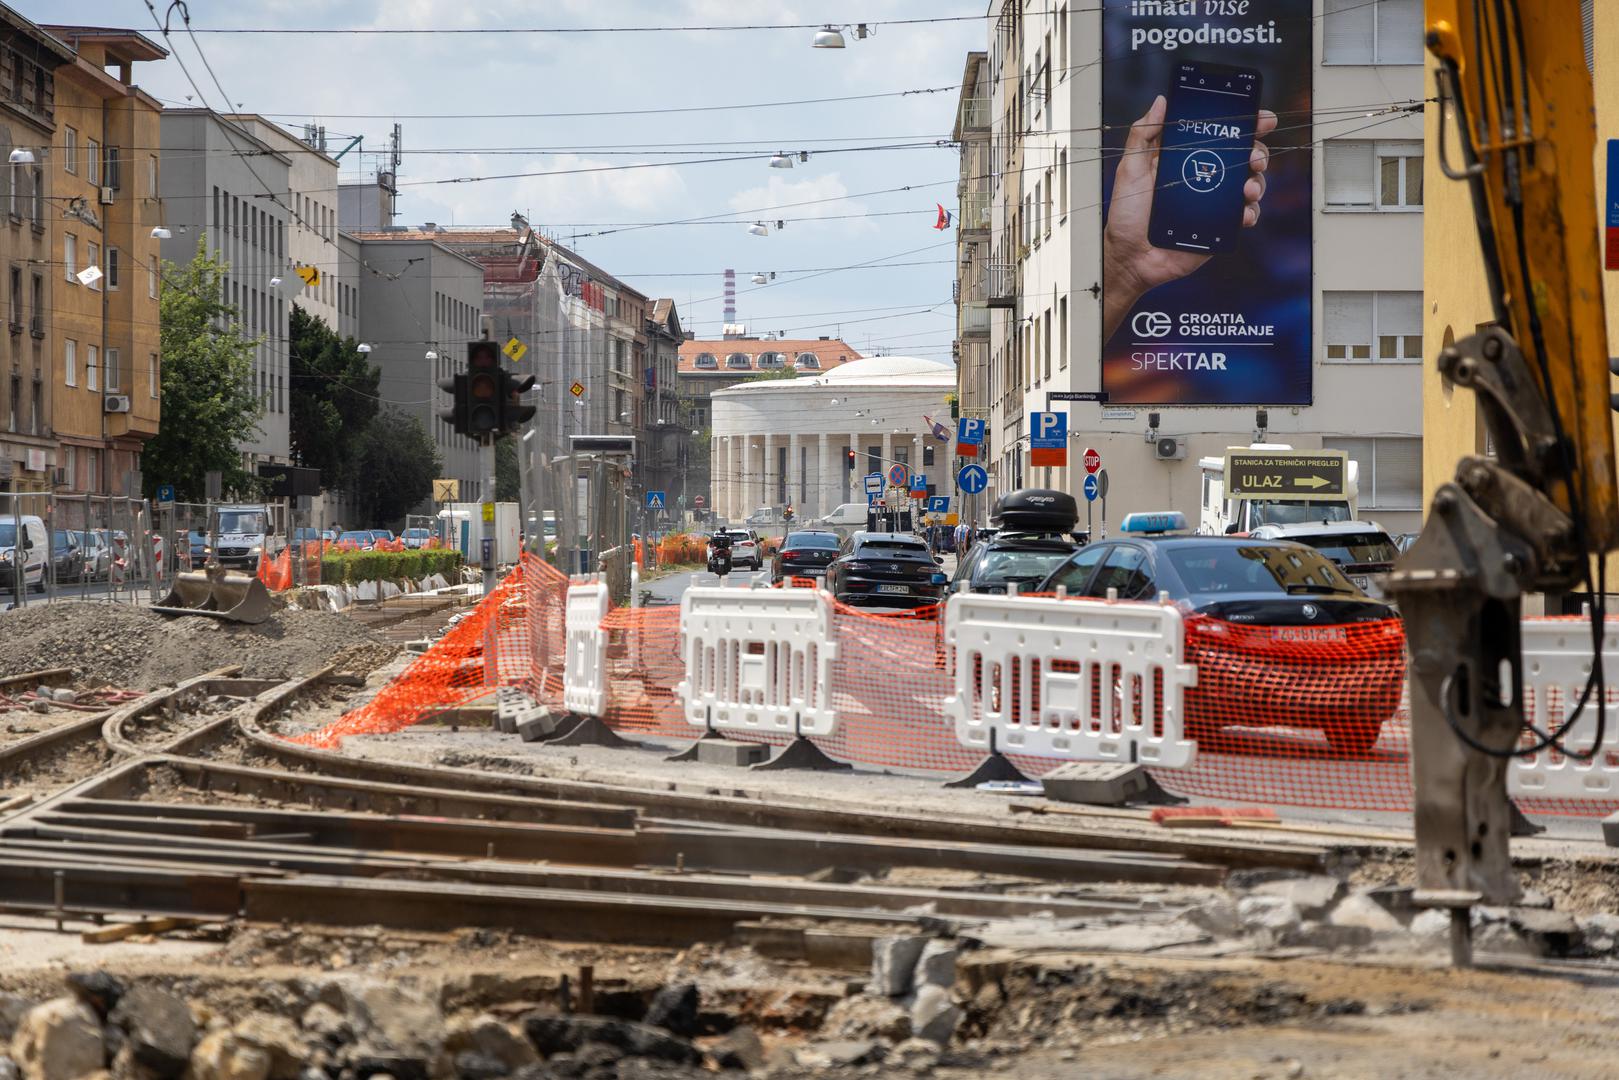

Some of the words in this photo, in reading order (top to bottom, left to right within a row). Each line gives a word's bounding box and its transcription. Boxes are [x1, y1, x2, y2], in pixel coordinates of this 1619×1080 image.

[1131, 20, 1282, 50] pogodnosti.
[1177, 119, 1241, 140] SPEKTAR
[1179, 313, 1245, 324] CROATIA
[1179, 325, 1274, 336] OSIGURANJE
[1131, 352, 1227, 370] SPEKTAR
[964, 419, 979, 437] P
[1040, 412, 1058, 438] P
[1084, 455, 1099, 467] STOP
[1275, 458, 1306, 467] TEHNIČKI
[914, 475, 922, 487] P
[1242, 475, 1283, 487] ULAZ
[162, 488, 169, 499] P
[933, 499, 944, 510] P
